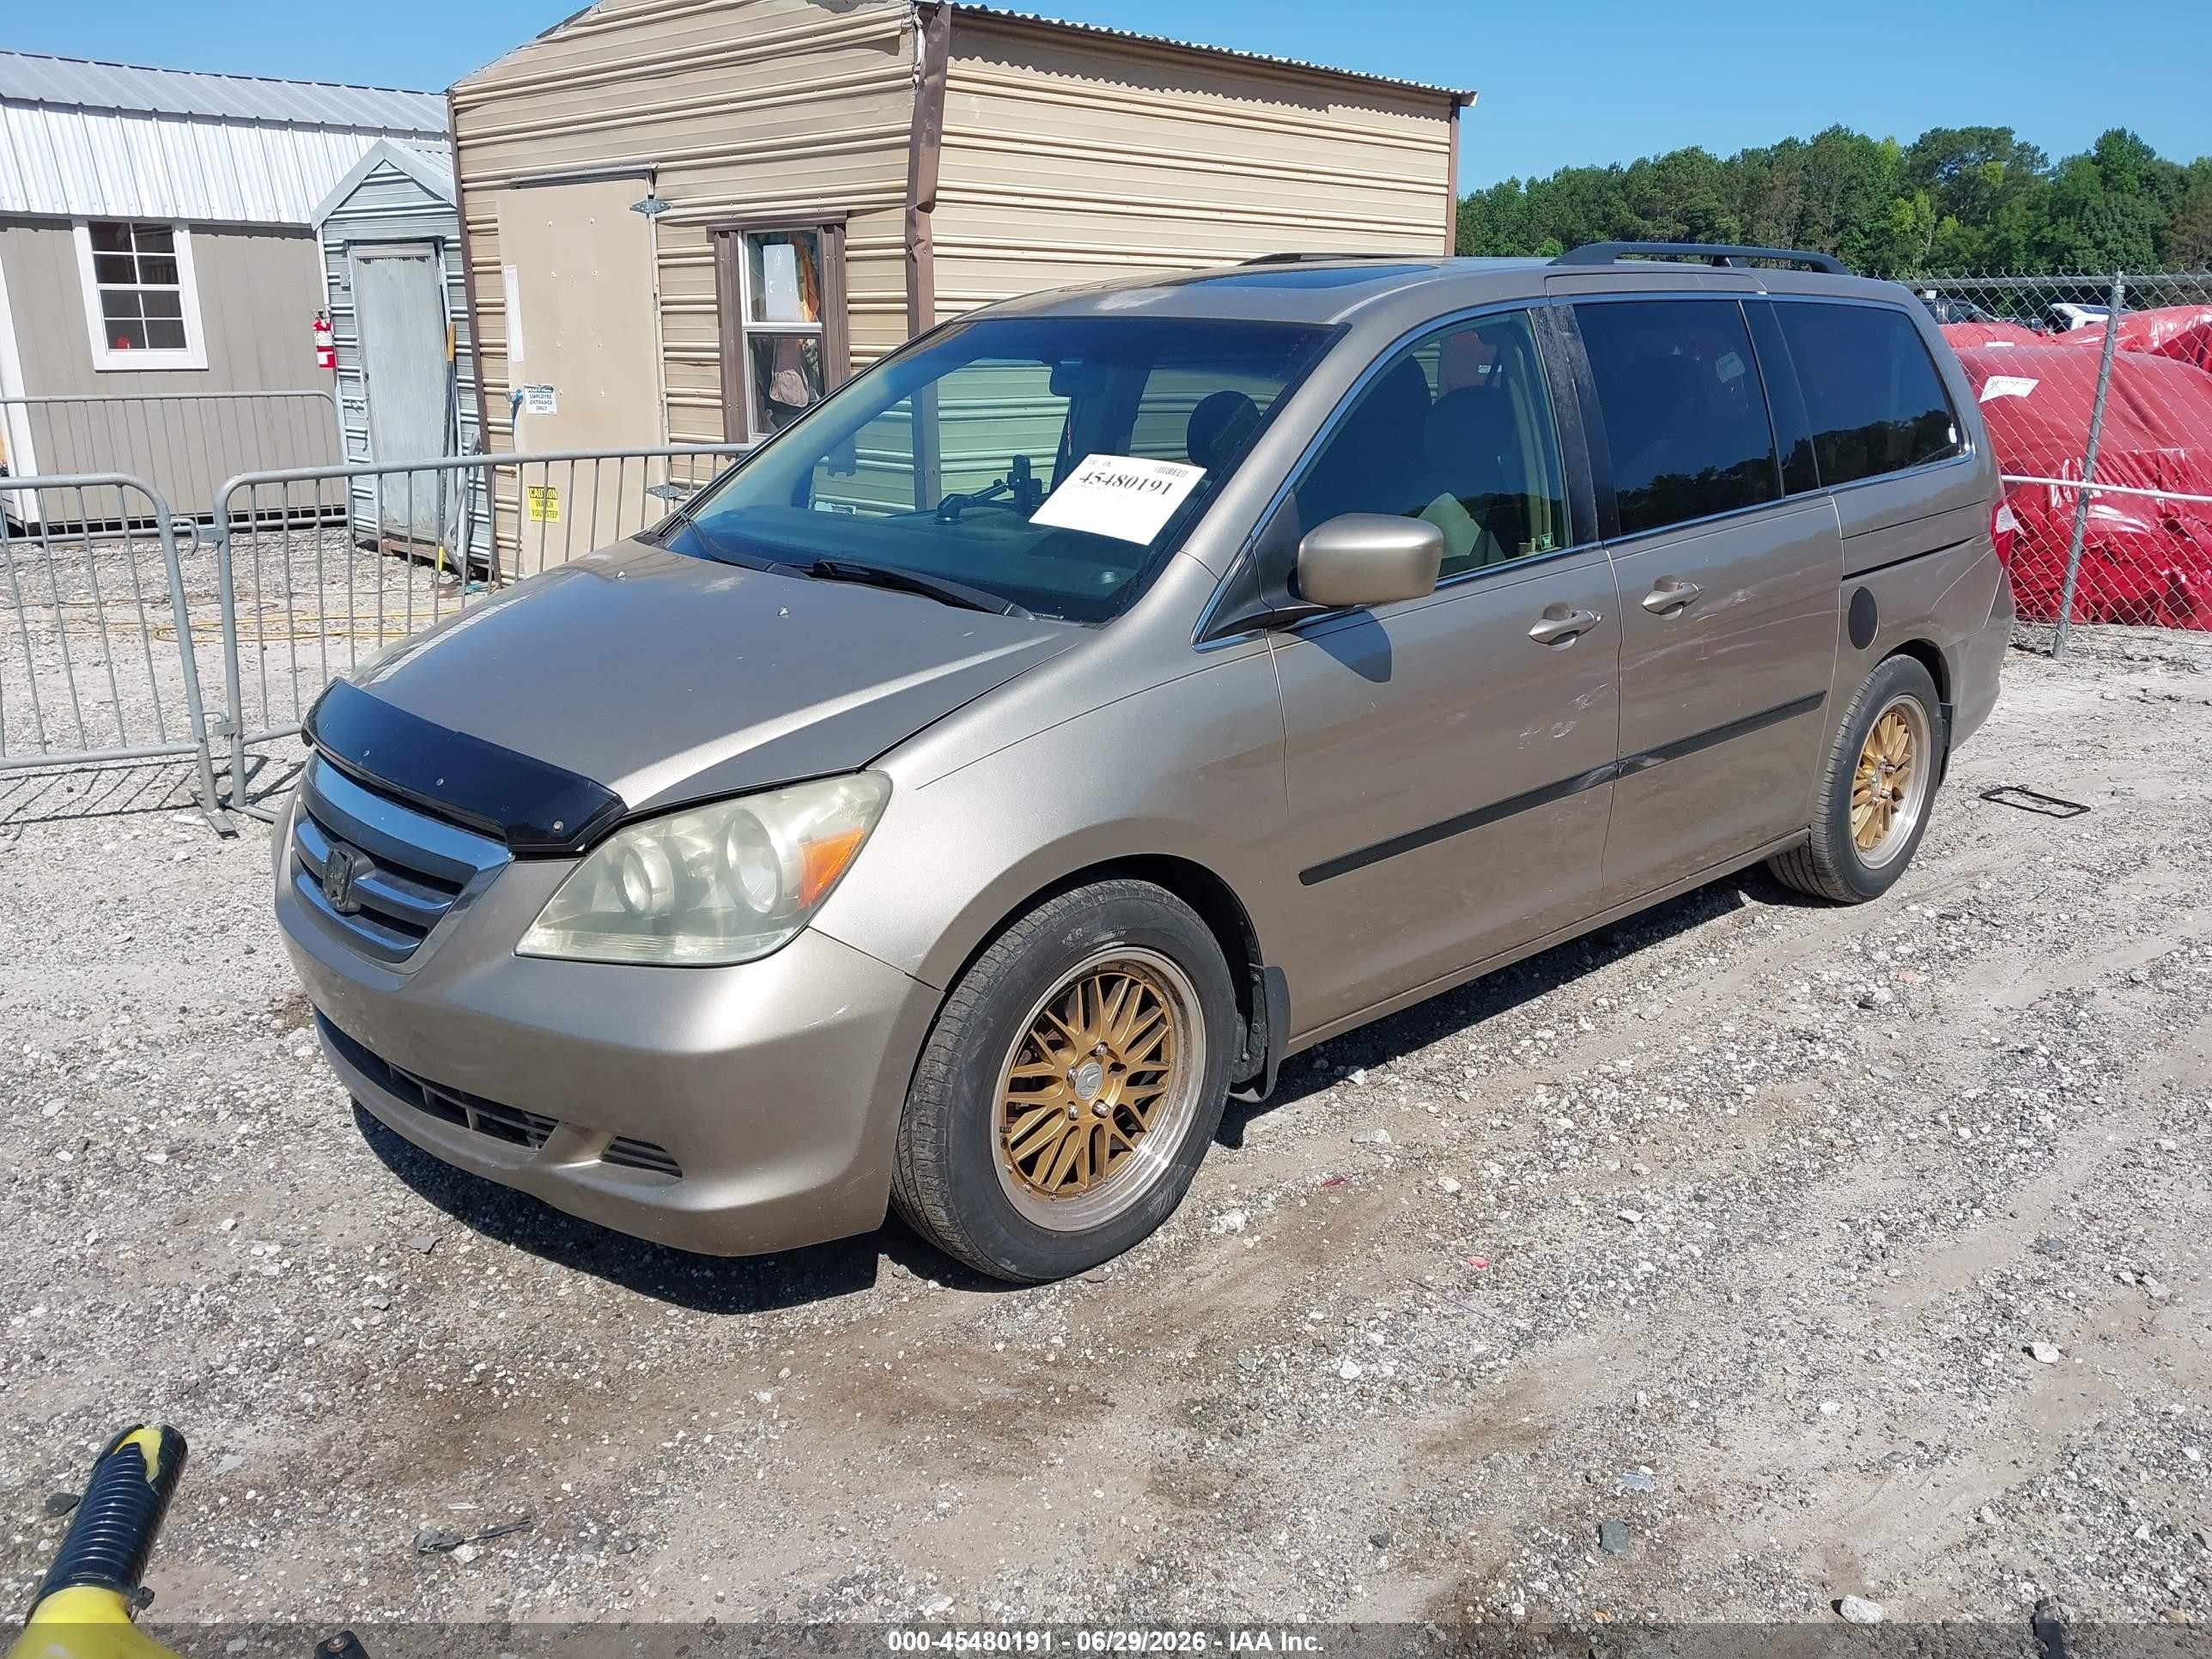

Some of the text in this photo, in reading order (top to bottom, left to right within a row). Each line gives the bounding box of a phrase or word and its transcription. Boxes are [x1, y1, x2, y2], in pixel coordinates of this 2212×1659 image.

[1079, 471, 1174, 495] 45480191
[529, 488, 558, 499] CAUION
[536, 499, 554, 508] WACH
[546, 510, 558, 519] STEP
